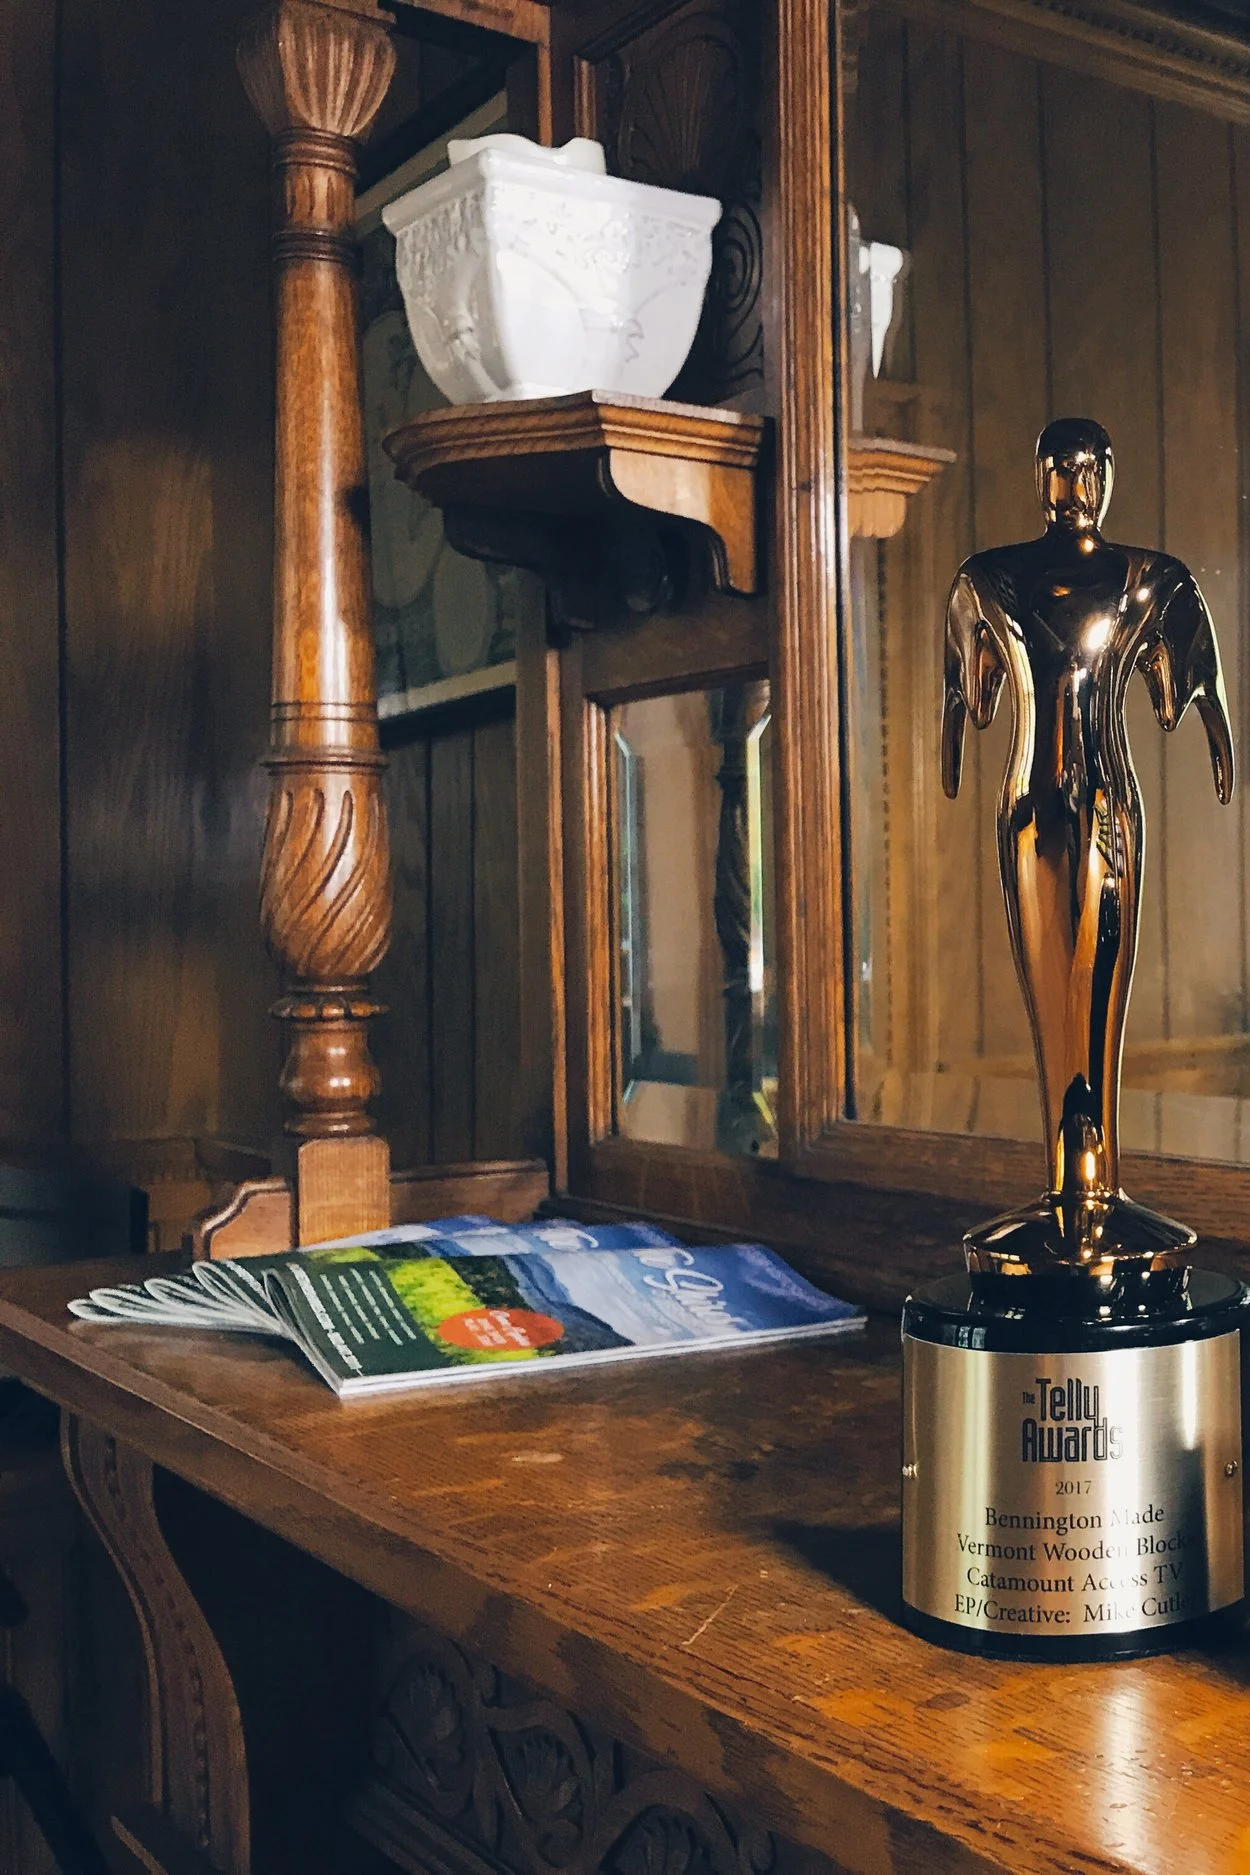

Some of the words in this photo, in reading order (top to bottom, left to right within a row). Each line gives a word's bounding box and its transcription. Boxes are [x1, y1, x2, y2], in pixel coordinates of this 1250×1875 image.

[1035, 1378, 1100, 1422] Telly
[1021, 1417, 1124, 1463] Awards
[1055, 1480, 1093, 1497] 2017
[984, 1505, 1102, 1537] Bennington
[956, 1532, 1037, 1562] Vermont
[1043, 1540, 1129, 1562] Wooden
[966, 1566, 1074, 1594] Catamount
[1153, 1561, 1186, 1586] TV
[954, 1593, 1071, 1625] EP/Creative:
[1083, 1602, 1136, 1624] Mike
[1141, 1592, 1194, 1617] Cutle
